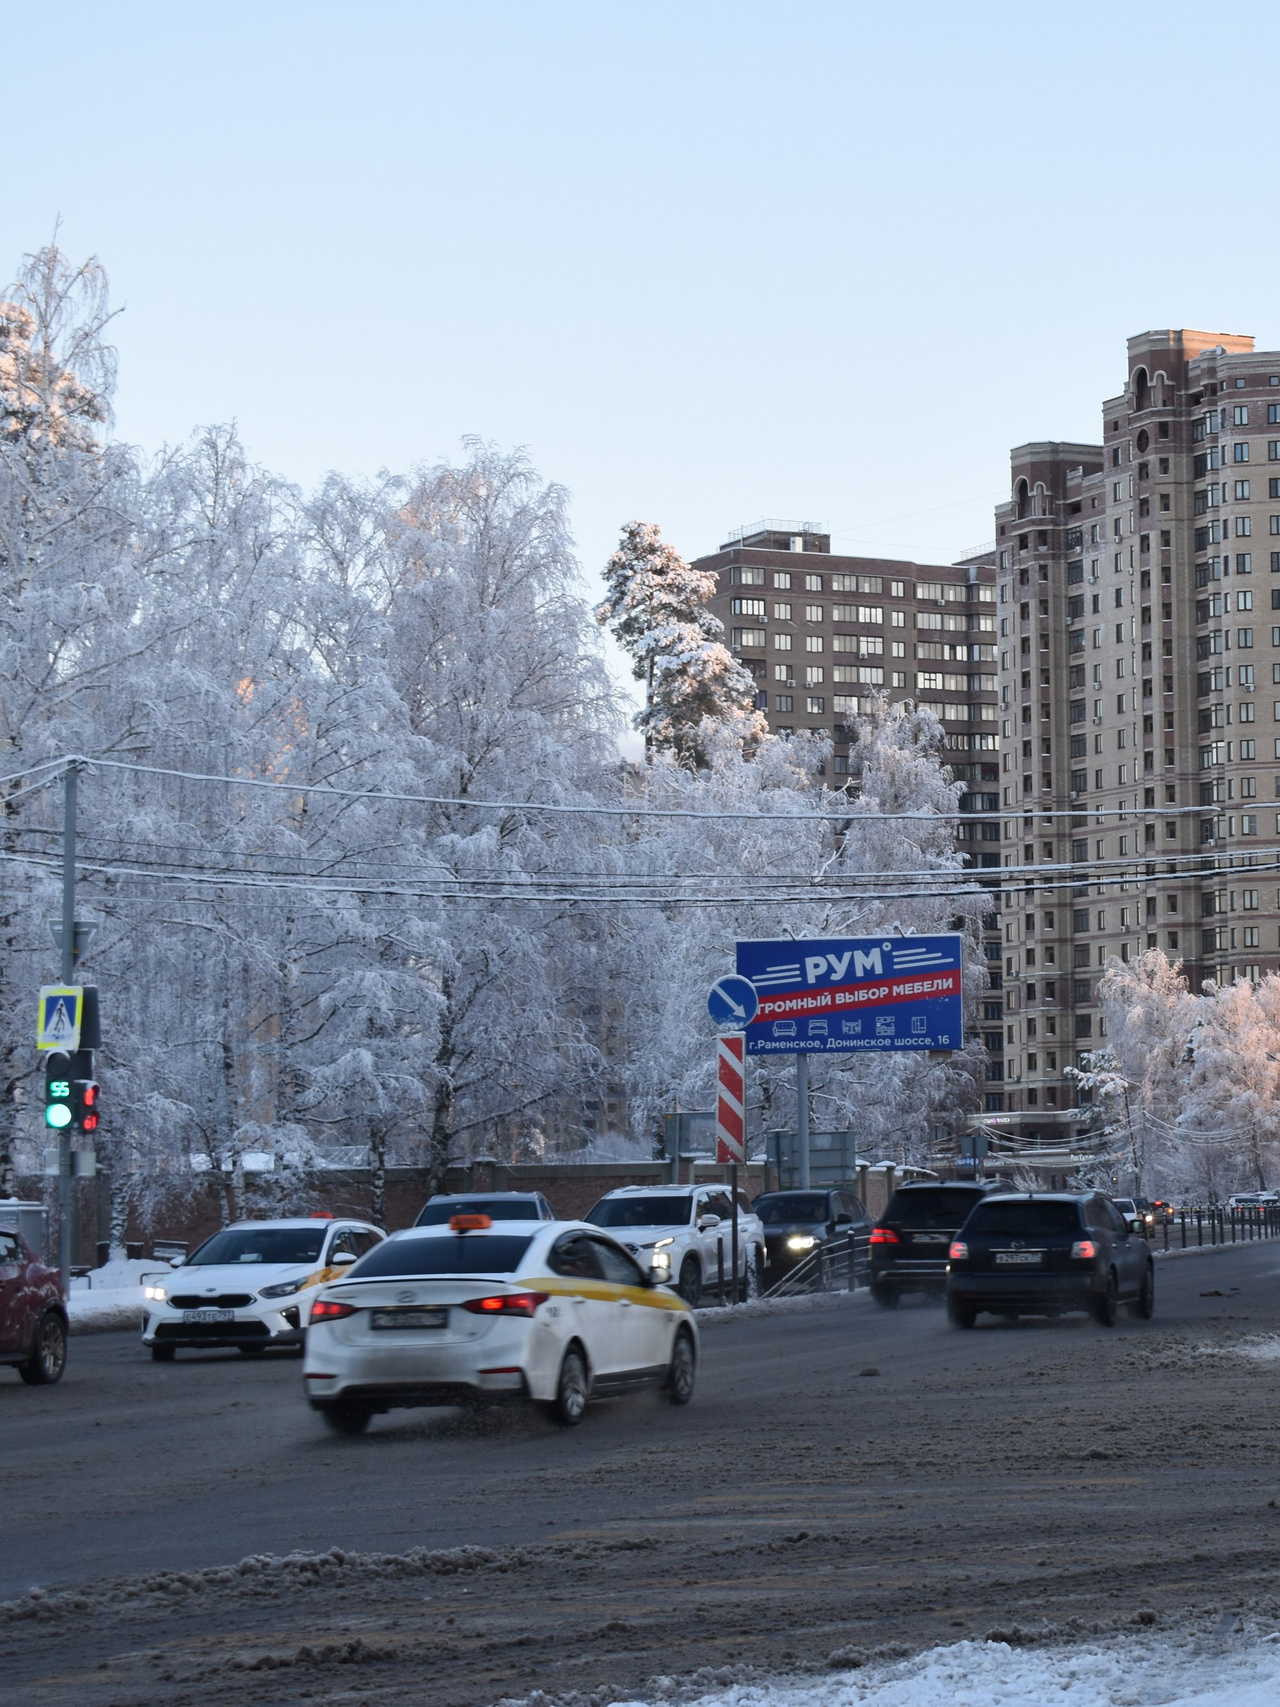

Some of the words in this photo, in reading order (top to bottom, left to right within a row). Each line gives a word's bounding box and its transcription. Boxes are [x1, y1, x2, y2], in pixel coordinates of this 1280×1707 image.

[757, 992, 832, 1015] ГРОМНЫЙ
[835, 987, 889, 1004] ВЫБОР
[892, 978, 953, 997] МЕБЕЛИ
[826, 1038, 891, 1049] Донинское
[894, 1036, 935, 1046] шоссе,
[937, 1035, 950, 1045] 16
[50, 1081, 70, 1097] 55
[83, 1115, 97, 1130] 61
